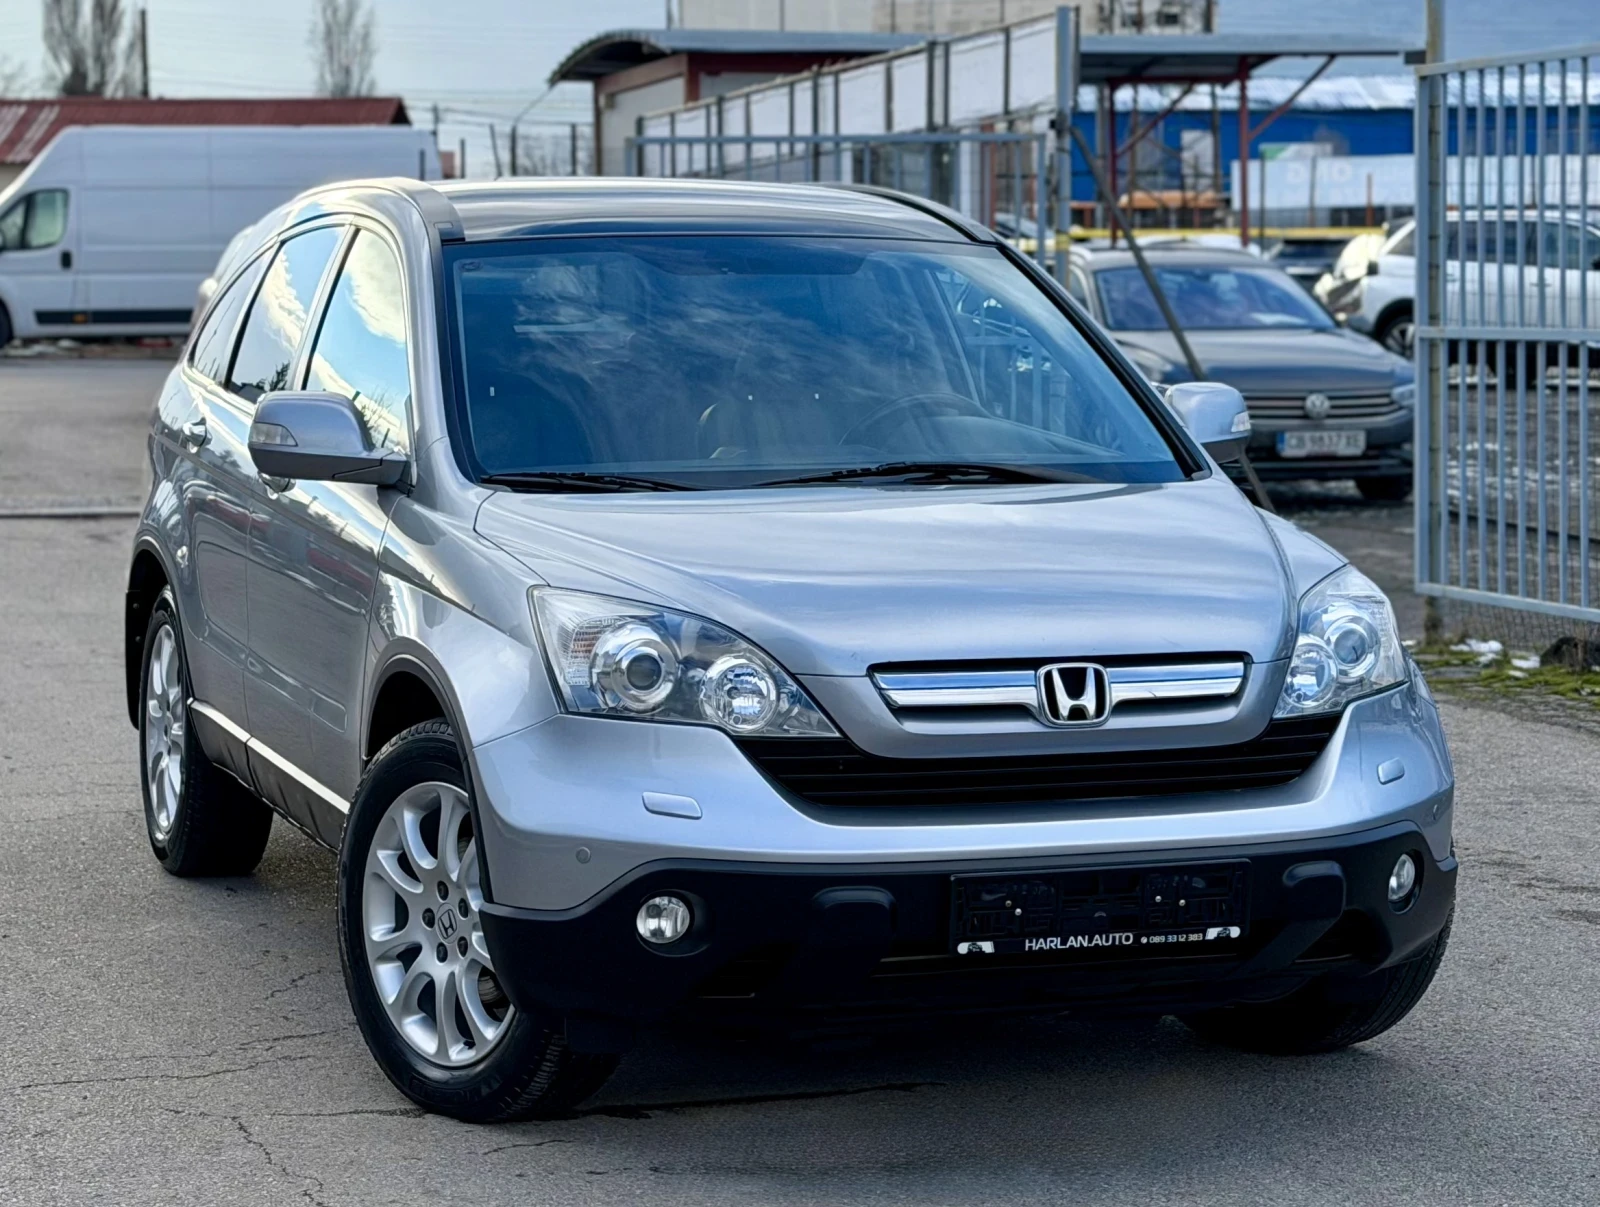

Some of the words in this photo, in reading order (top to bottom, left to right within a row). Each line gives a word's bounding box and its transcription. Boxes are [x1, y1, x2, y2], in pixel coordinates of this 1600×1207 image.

[1024, 932, 1134, 951] HARLAN.AUTO
[1149, 935, 1165, 944] 089
[1166, 934, 1178, 943] 33
[1178, 934, 1187, 942] 12
